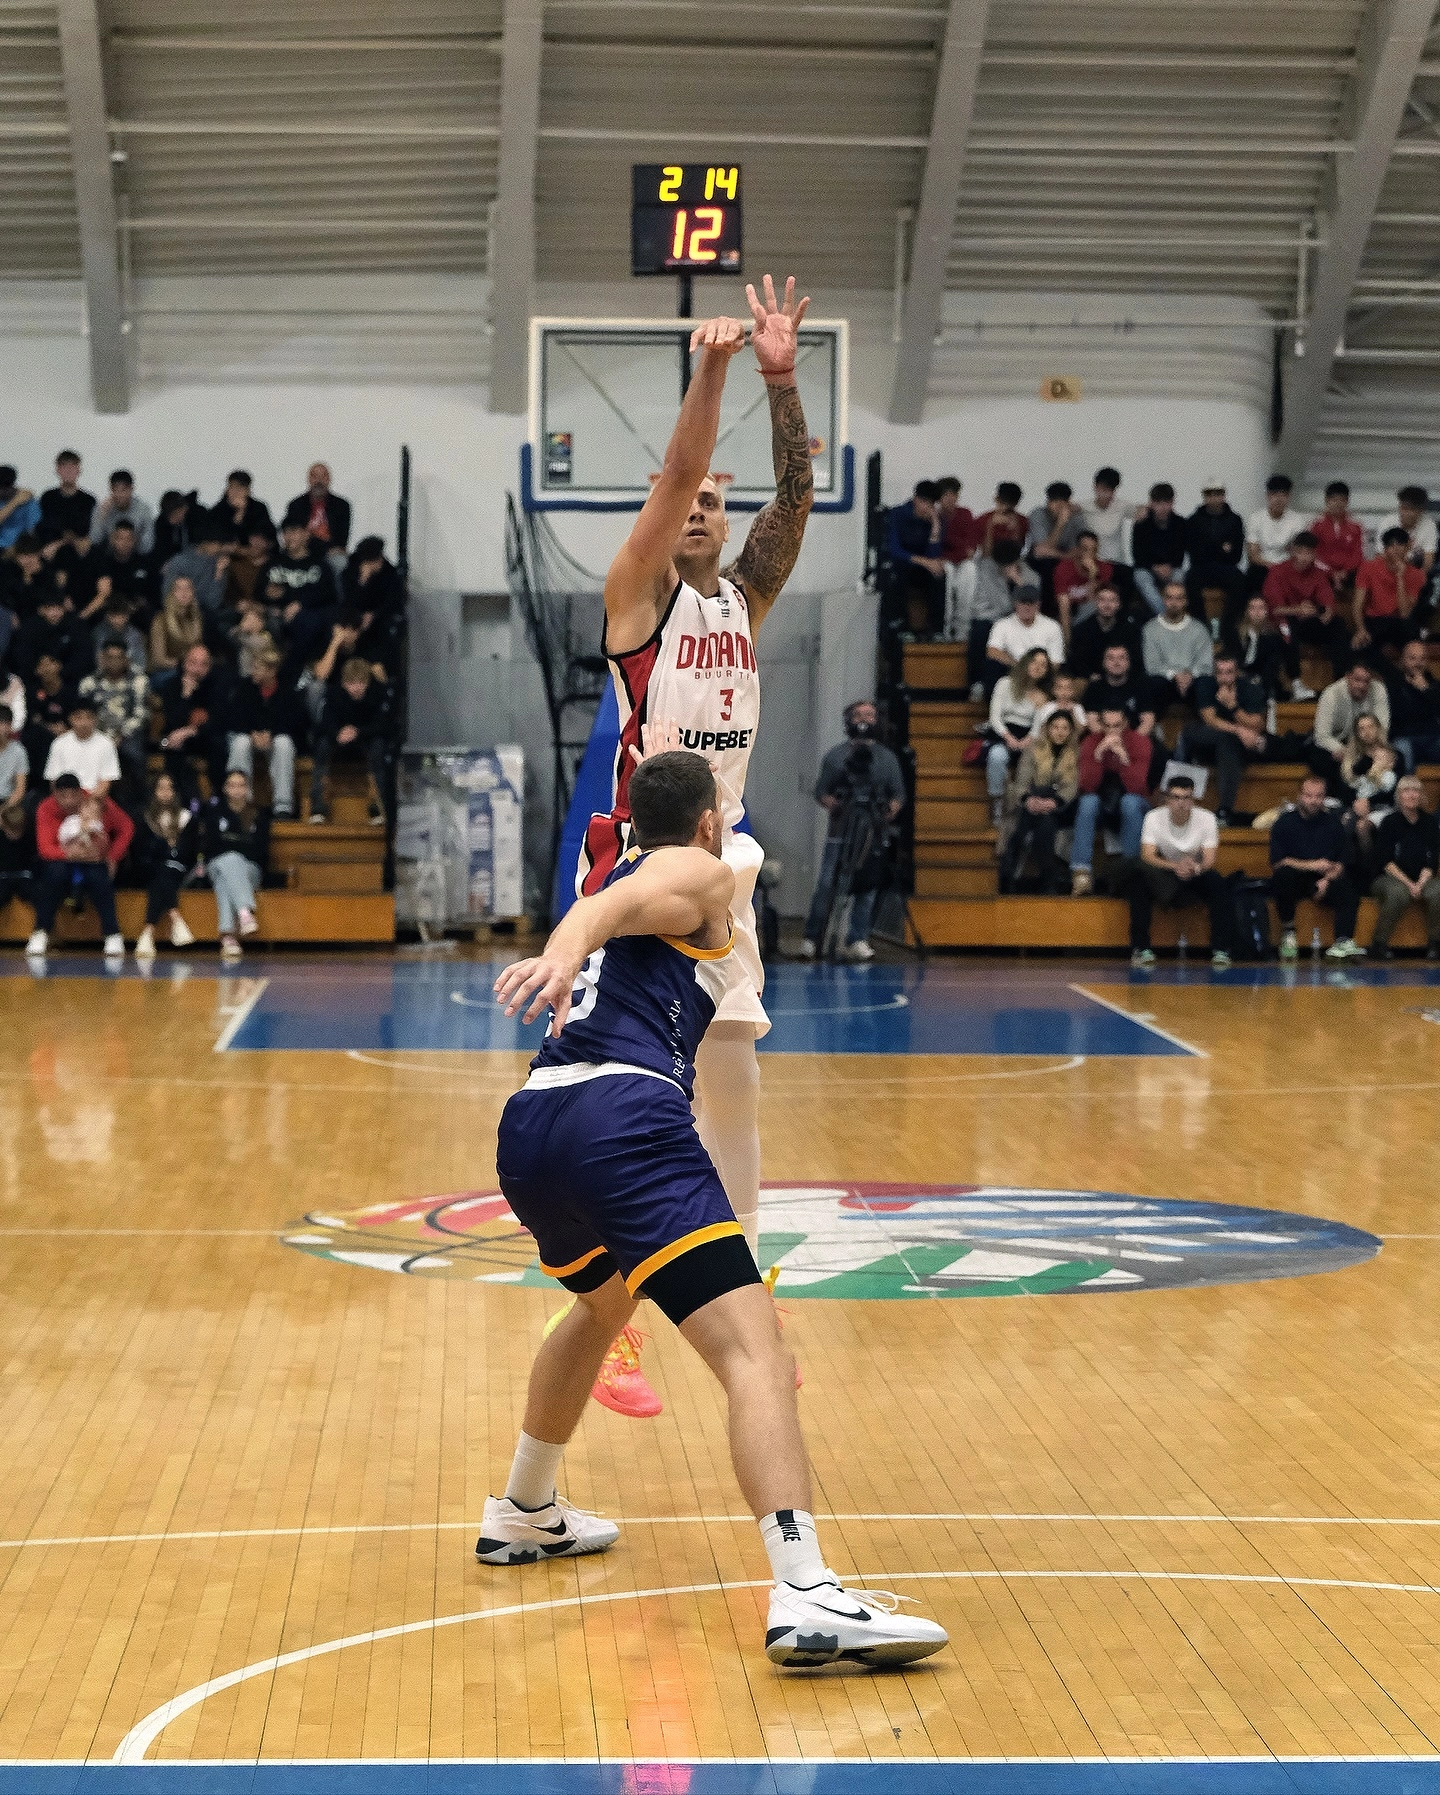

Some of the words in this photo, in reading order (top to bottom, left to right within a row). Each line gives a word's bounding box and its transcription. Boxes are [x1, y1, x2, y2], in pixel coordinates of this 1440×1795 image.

[659, 166, 683, 202] 2
[705, 167, 738, 200] 14
[672, 208, 724, 260] 12
[720, 689, 734, 721] 3
